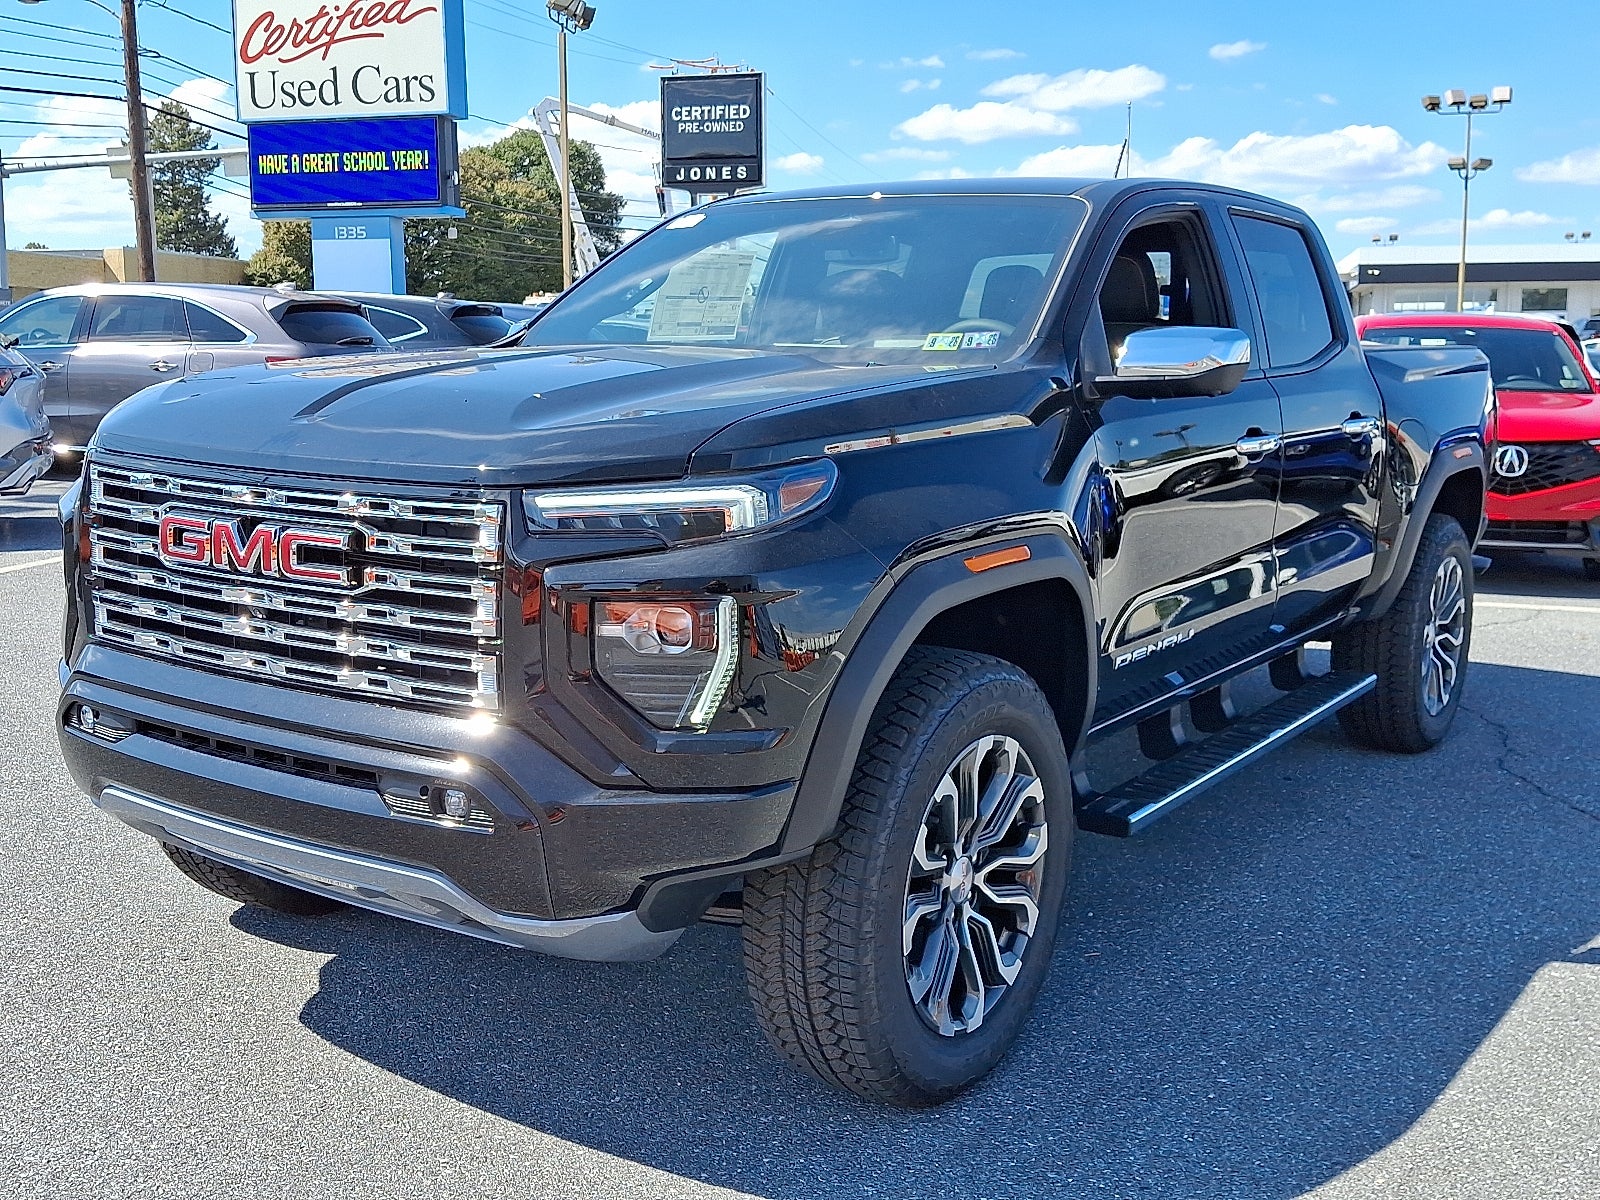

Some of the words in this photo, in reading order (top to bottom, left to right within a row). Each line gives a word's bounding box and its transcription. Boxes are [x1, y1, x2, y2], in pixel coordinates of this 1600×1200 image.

[240, 0, 437, 64] Certified
[245, 66, 342, 109] Used
[351, 64, 436, 105] Cars
[671, 104, 751, 121] CERTIFIED
[678, 121, 745, 134] PRE-OWNED
[258, 154, 289, 175] HAVE
[291, 154, 300, 174] A
[302, 152, 340, 174] GREAT
[343, 151, 390, 172] SCHOOL
[391, 149, 429, 170] YEAR!
[675, 166, 748, 181] JONES
[334, 226, 367, 239] 1335
[929, 337, 937, 348] 9
[966, 336, 974, 347] 9
[159, 515, 348, 582] GMC
[1113, 628, 1195, 671] DENALI
